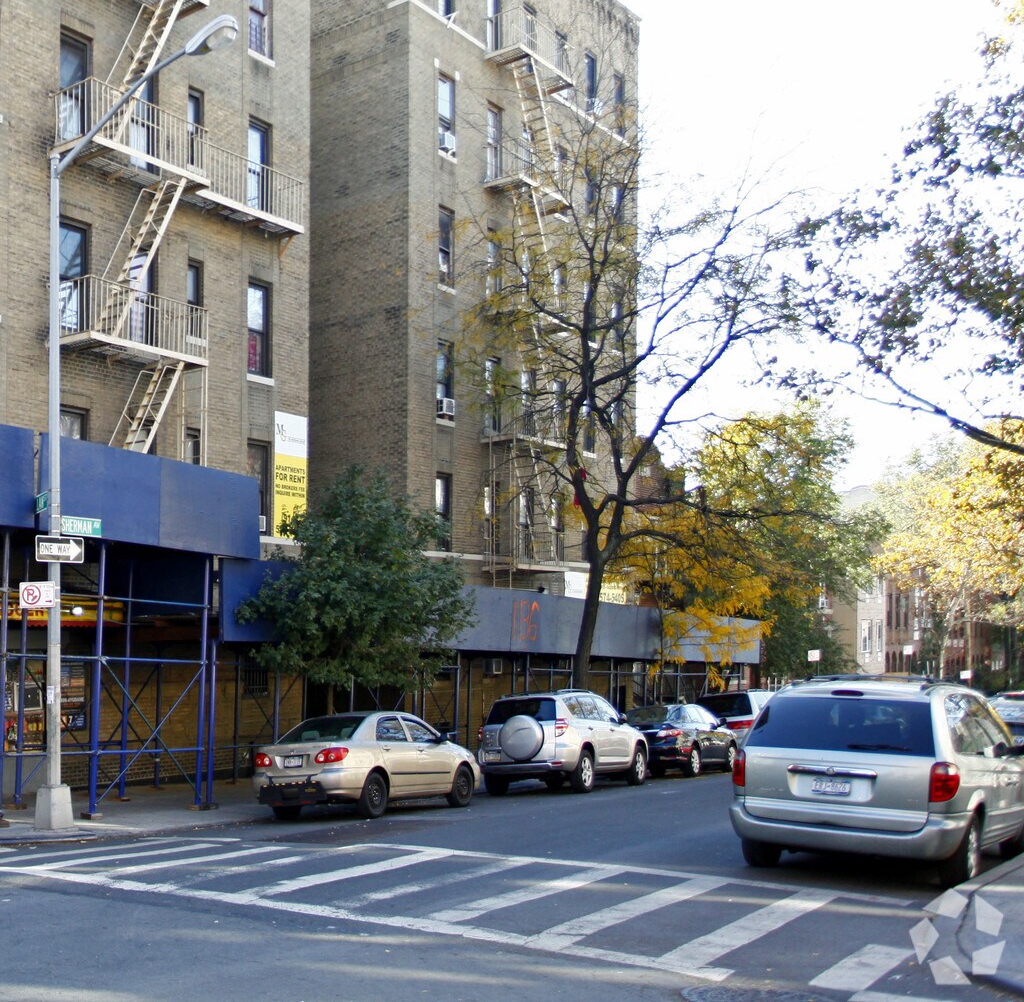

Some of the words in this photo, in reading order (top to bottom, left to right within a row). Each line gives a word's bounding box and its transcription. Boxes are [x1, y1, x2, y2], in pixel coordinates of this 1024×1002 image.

[276, 465, 305, 475] APARTMENTS
[276, 472, 287, 482] FOR
[289, 475, 305, 484] RENT
[62, 518, 92, 534] SHERMAN
[40, 544, 53, 554] ONE
[57, 545, 70, 554] WAY
